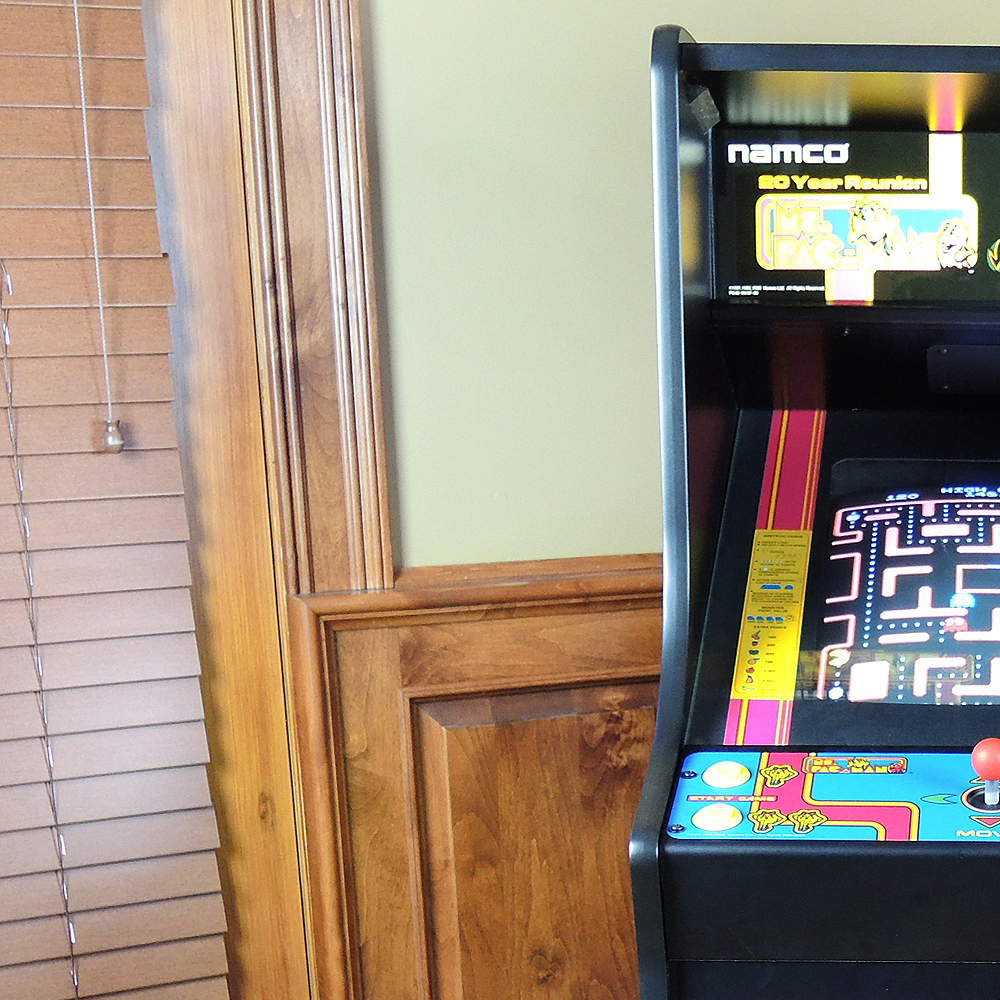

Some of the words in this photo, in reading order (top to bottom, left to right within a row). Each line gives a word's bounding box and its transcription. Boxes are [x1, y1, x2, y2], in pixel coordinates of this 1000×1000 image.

[727, 142, 850, 164] namco
[758, 174, 790, 190] 20
[791, 174, 843, 190] Year
[844, 174, 928, 190] Reunion
[940, 486, 988, 494] HIGH
[885, 493, 920, 502] 120
